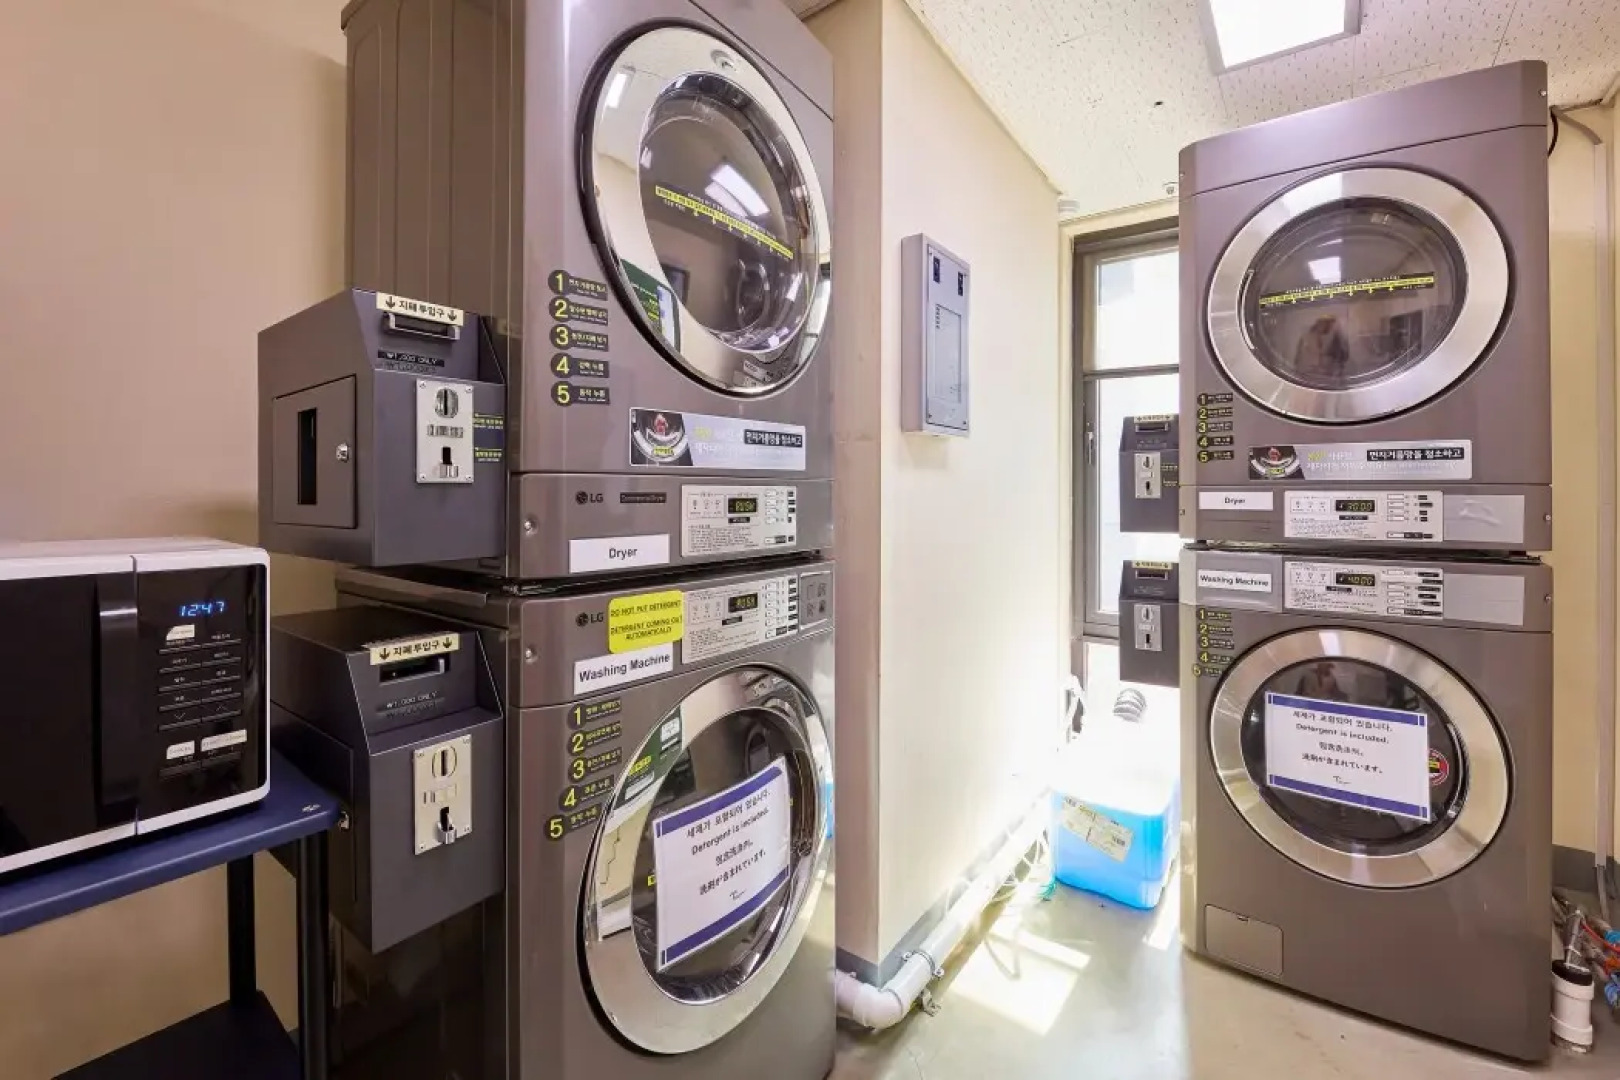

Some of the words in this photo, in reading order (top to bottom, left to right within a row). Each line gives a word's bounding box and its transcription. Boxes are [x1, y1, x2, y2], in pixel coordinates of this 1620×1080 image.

[555, 273, 563, 292] 1
[400, 300, 444, 318] 지폐투입구
[555, 299, 568, 318] 2
[556, 326, 569, 345] 3
[556, 356, 570, 374] 4
[557, 385, 570, 403] 5
[1199, 394, 1206, 405] 1
[1199, 408, 1207, 419] 2
[1199, 422, 1206, 433] 3
[1200, 437, 1208, 447] 4
[1201, 451, 1208, 462] 5
[590, 493, 604, 504] LG
[1225, 497, 1246, 506] Dryer
[608, 548, 638, 561] Dryer
[1200, 574, 1234, 586] Washing
[1235, 577, 1269, 587] Machine
[610, 609, 620, 617] DO
[621, 606, 635, 616] NOT
[636, 604, 649, 613] PUT
[649, 600, 682, 611] DETERGENT
[1199, 609, 1205, 620] 1
[590, 612, 604, 624] LG
[610, 622, 644, 635] DETERGENT
[646, 618, 670, 629] COMING
[626, 626, 672, 640] AUTOMATICALLY
[1200, 624, 1207, 634] 2
[393, 640, 439, 656] 지폐투입구
[1201, 636, 1209, 647] 3
[1200, 652, 1209, 663] 4
[579, 664, 627, 682] Washing
[630, 653, 670, 670] Machine
[574, 707, 581, 725] 1
[1293, 711, 1316, 721] 세제가
[1320, 714, 1352, 726] 포함되어
[1356, 720, 1393, 732] 있습니다.
[1296, 723, 1337, 735] Detergent
[1350, 731, 1390, 744] included.
[572, 733, 584, 752] 2
[573, 760, 584, 779] 3
[1302, 753, 1383, 774] 洗剤が含まれています。
[564, 788, 577, 806] 4
[686, 819, 711, 838] 세제가
[715, 804, 743, 826] 포함되어
[746, 788, 771, 809] 있습니다.
[550, 819, 563, 838] 5
[691, 829, 731, 855] Detergent
[733, 824, 740, 834] is
[741, 807, 770, 828] included.
[700, 849, 766, 895] 洗剤が含まれています。
